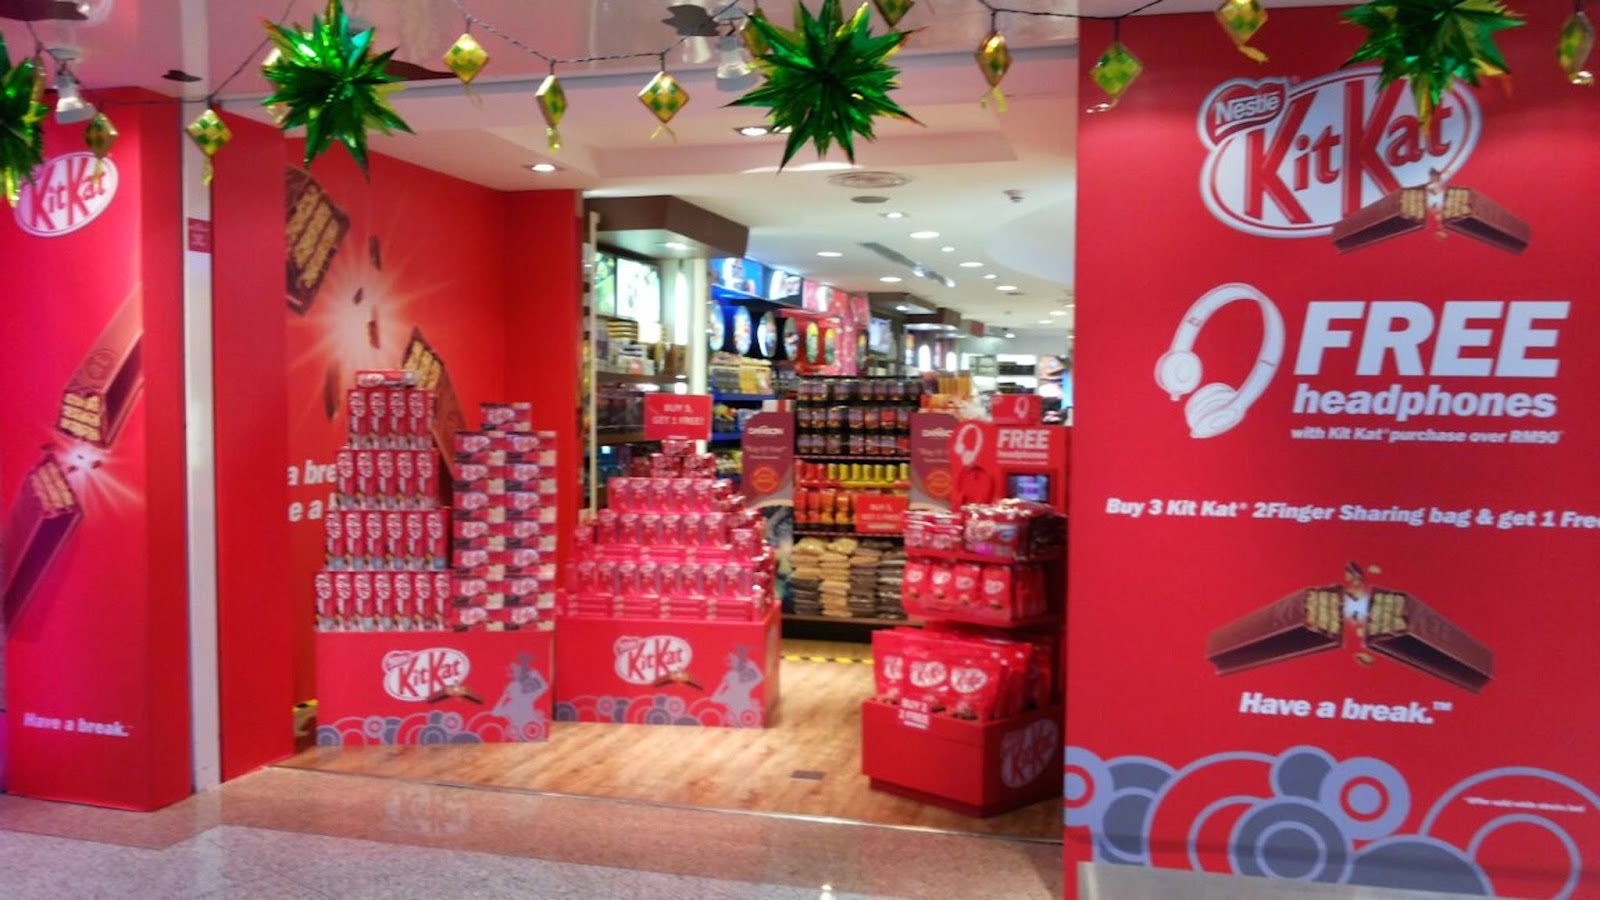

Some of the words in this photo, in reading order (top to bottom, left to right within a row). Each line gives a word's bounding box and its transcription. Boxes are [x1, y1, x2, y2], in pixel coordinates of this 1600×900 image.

[1294, 300, 1571, 378] FREE
[1293, 383, 1557, 421] headphones
[997, 429, 1050, 449] FREE
[1291, 426, 1325, 440] with
[1328, 426, 1351, 440] Kit
[1389, 428, 1466, 443] purchase
[1469, 430, 1508, 443] over
[303, 459, 337, 485] bre
[1106, 498, 1145, 518] Buy
[1148, 499, 1162, 515] 3
[1166, 499, 1197, 516] Kit
[1252, 502, 1335, 523] 2Finger
[1339, 504, 1426, 526] Sharing
[1429, 506, 1473, 528] bag
[1475, 508, 1494, 525] &
[1497, 509, 1537, 530] get
[1541, 510, 1556, 528] 1
[1239, 692, 1311, 716] Have
[1316, 700, 1336, 718] a
